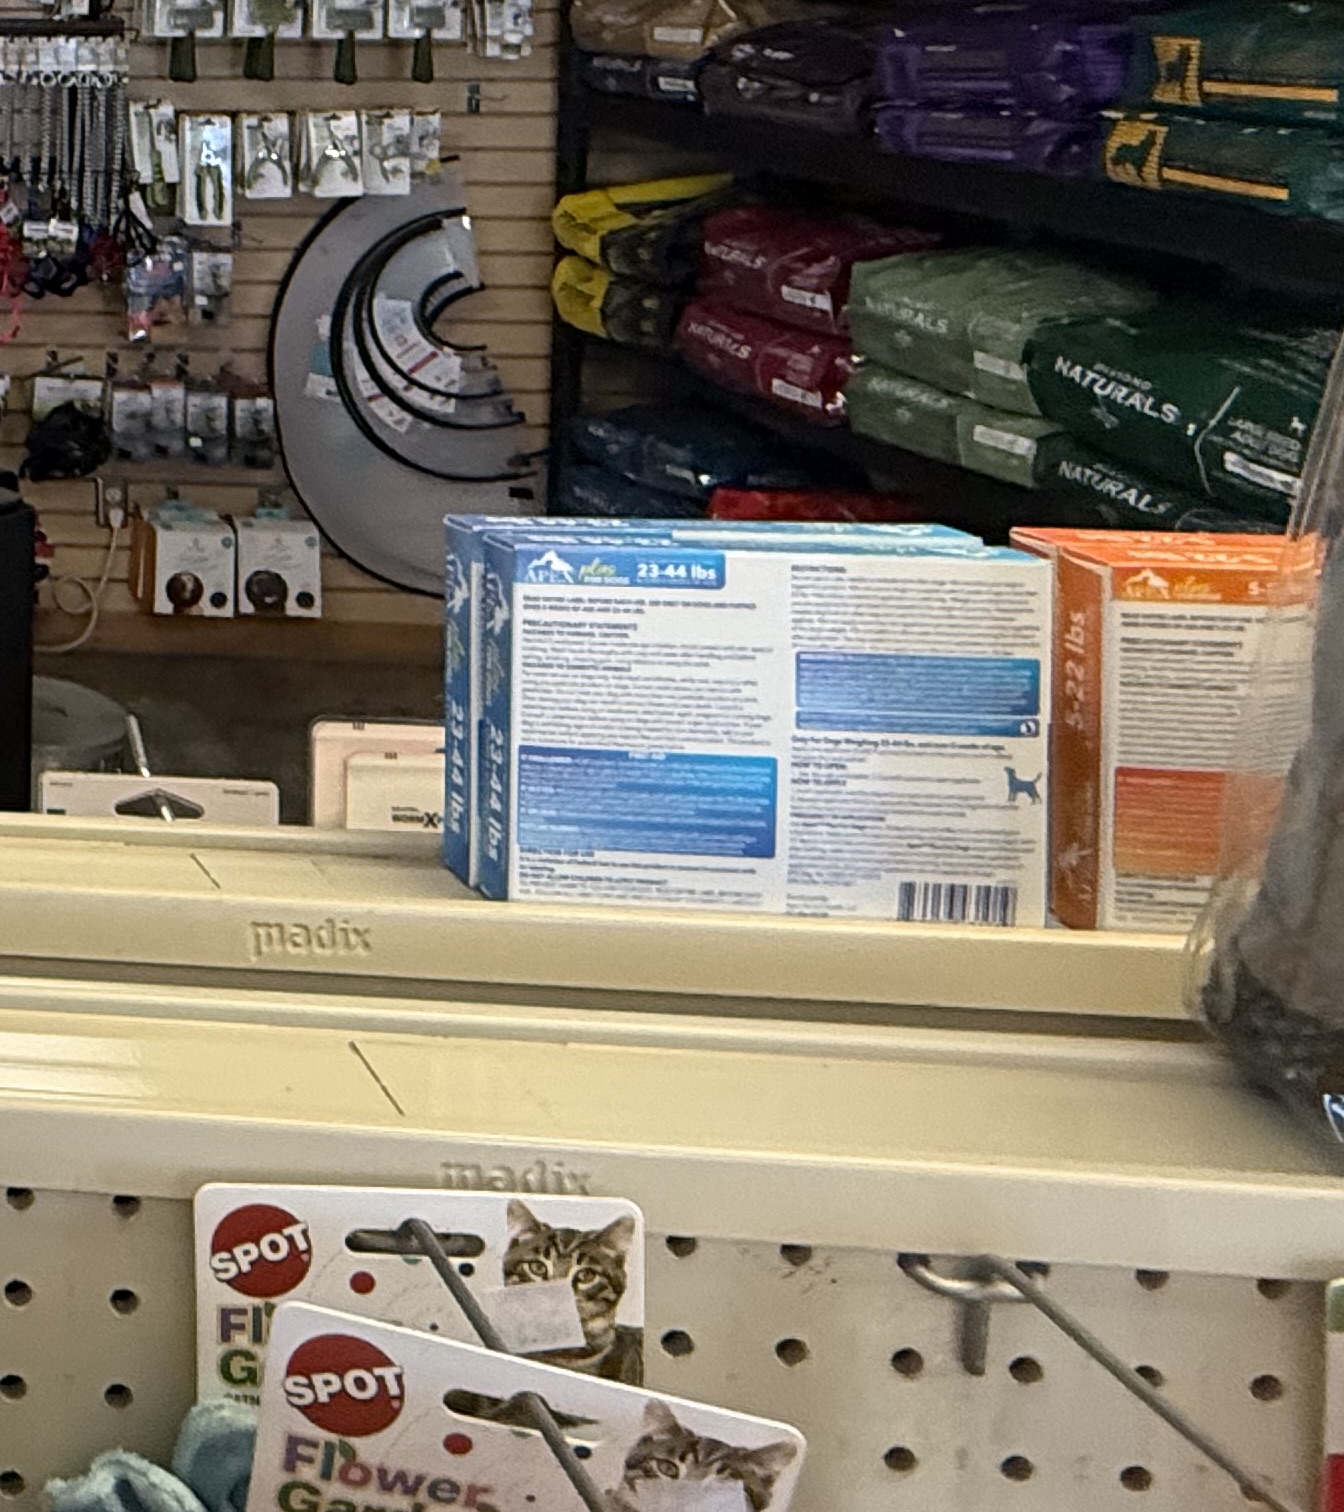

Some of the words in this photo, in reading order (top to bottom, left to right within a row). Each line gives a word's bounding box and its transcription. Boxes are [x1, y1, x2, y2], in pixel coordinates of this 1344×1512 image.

[1054, 355, 1182, 425] NATURALS
[1059, 460, 1174, 514] NATURALS
[637, 563, 687, 579] 23-44
[690, 561, 717, 580] lbs
[1065, 610, 1087, 654] lbs
[1065, 659, 1086, 729] 5-22
[449, 700, 465, 786] 23-44
[487, 722, 505, 812] 23-44
[448, 789, 465, 835] lbs
[487, 815, 504, 862] lbs
[209, 1221, 311, 1282] SPOT
[283, 1365, 405, 1407] SPOT
[282, 1433, 500, 1508] Flower
